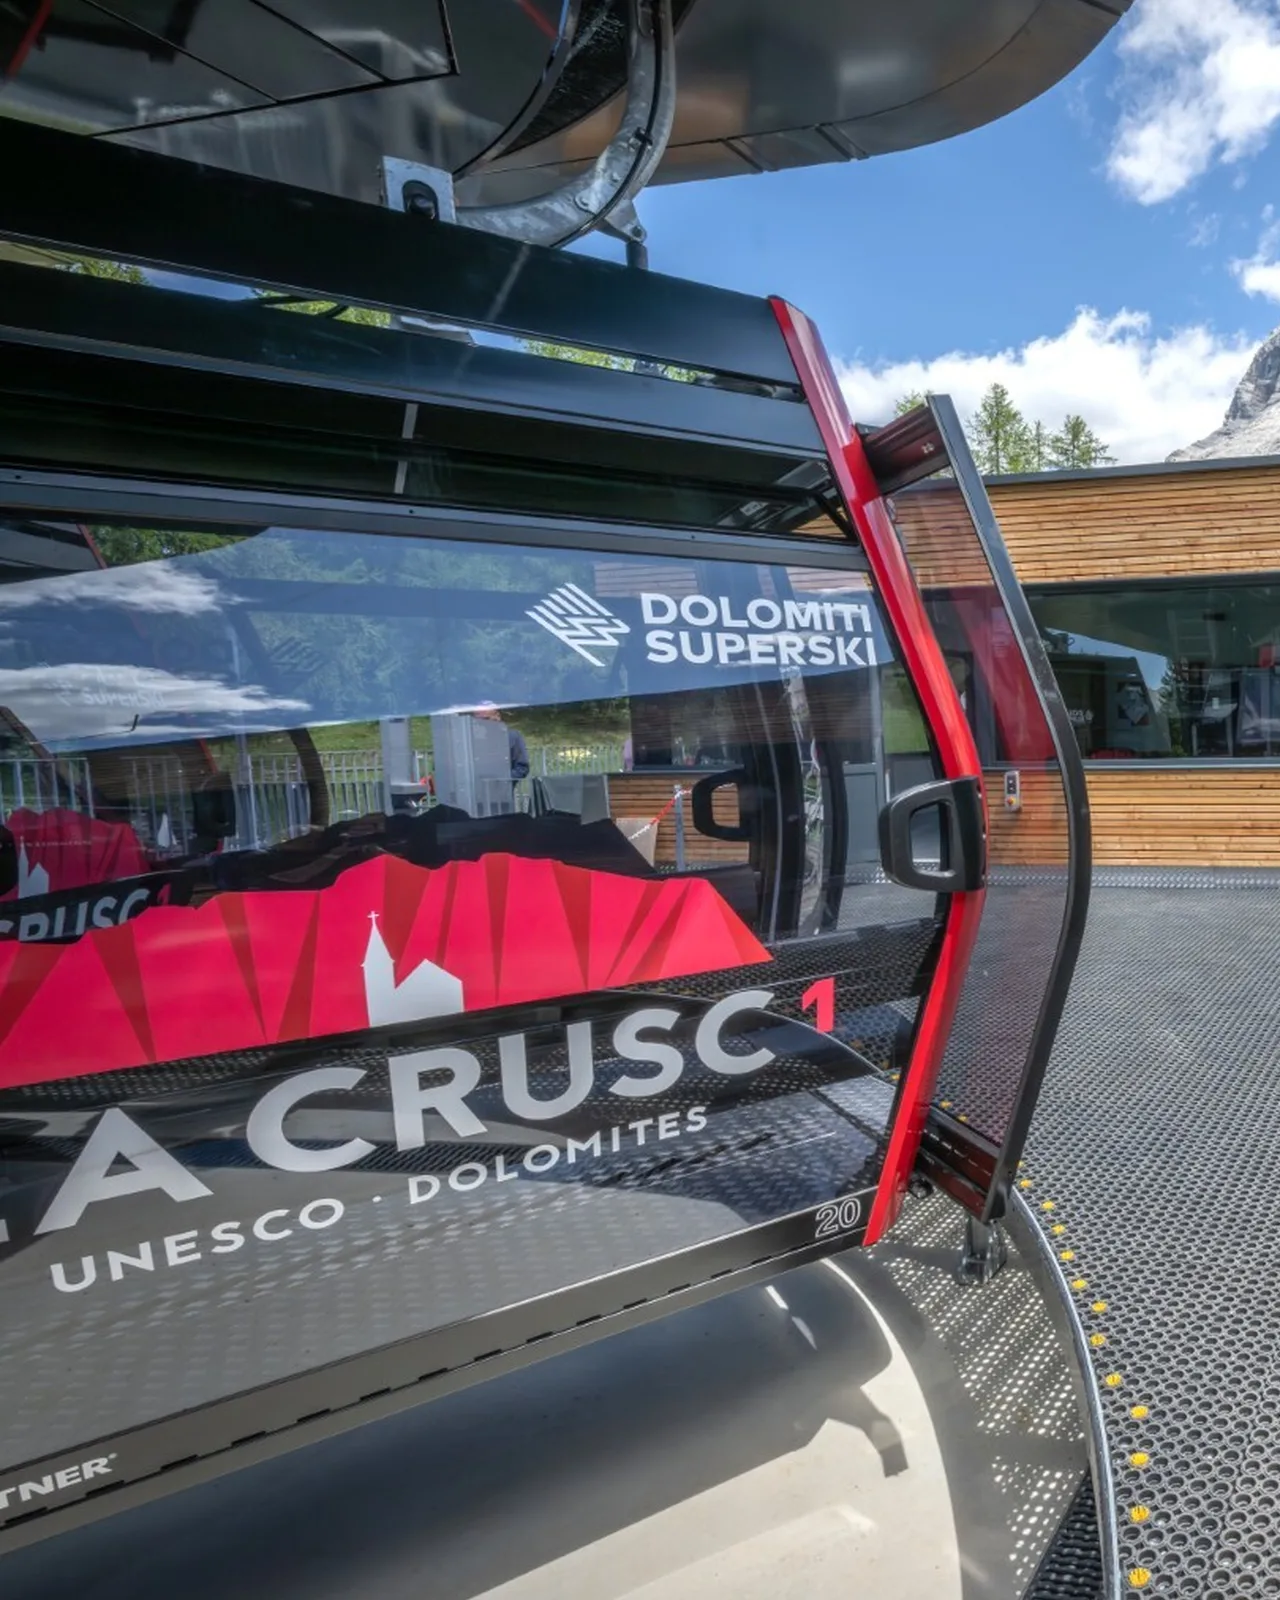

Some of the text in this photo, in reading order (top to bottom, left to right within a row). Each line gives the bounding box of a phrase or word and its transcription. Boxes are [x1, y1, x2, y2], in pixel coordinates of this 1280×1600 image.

[640, 592, 873, 632] DOLOMITI
[645, 630, 878, 666] SUPERSKI
[50, 1106, 708, 1293] UNESCO DOLOMITES
[814, 1197, 862, 1238] 20
